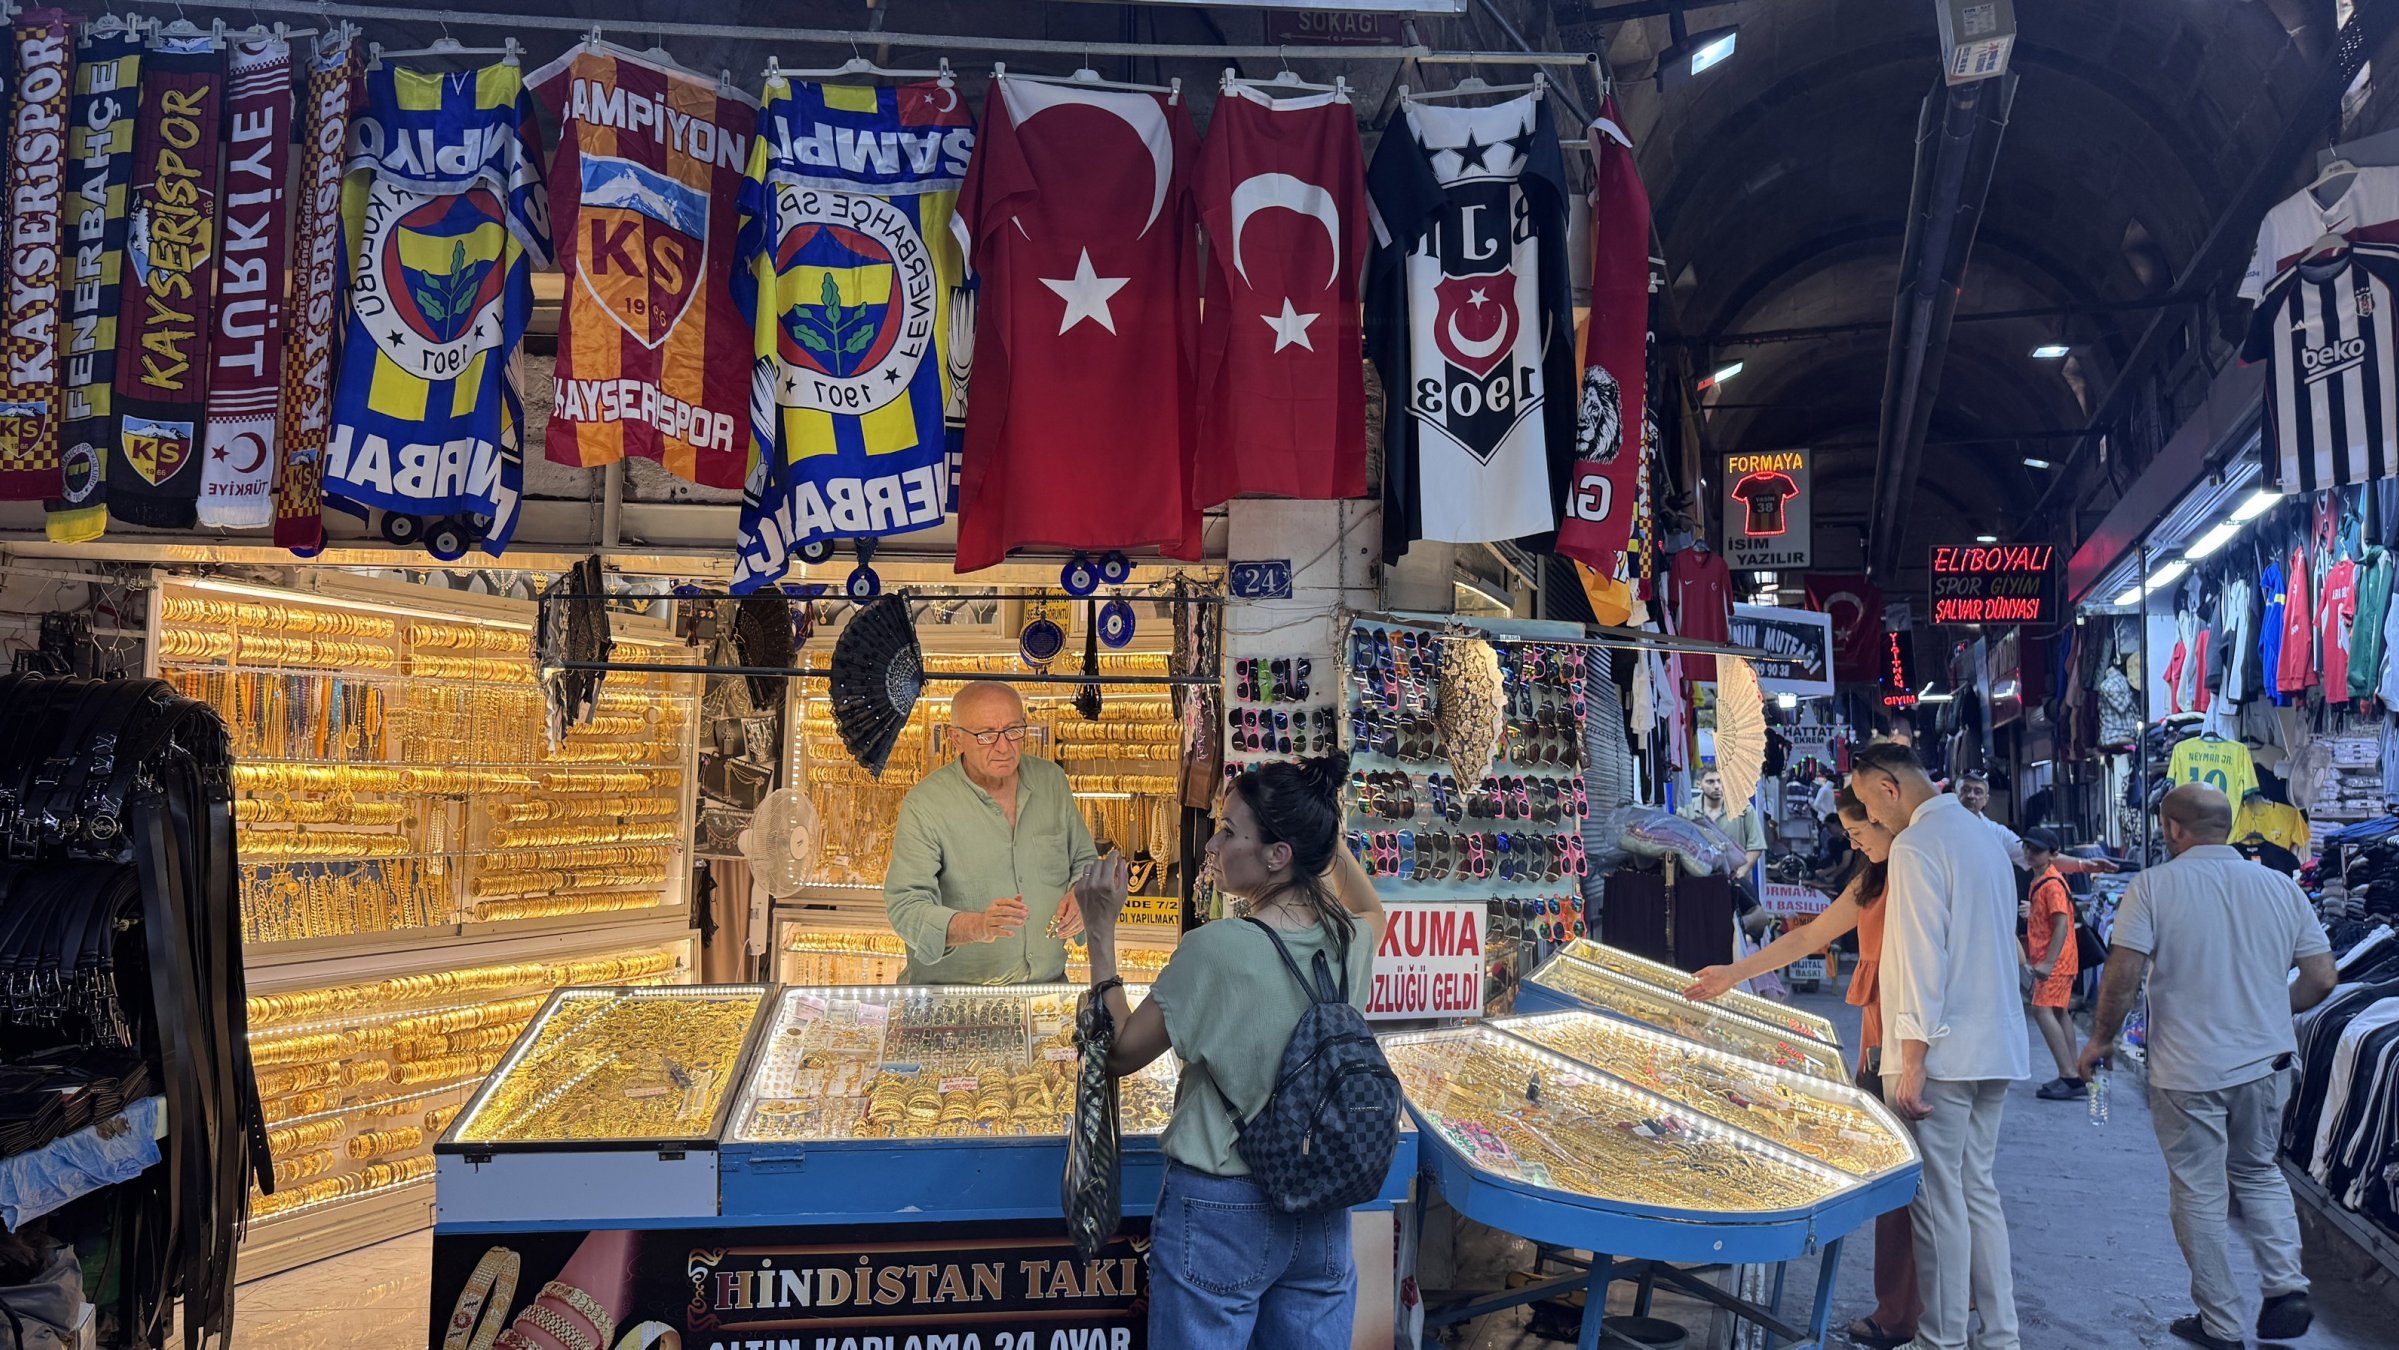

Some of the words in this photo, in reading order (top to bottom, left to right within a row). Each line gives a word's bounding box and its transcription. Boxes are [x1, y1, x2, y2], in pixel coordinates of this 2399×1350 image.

[559, 78, 745, 174] AMPİYON
[66, 60, 121, 420] FENERBAHÇE
[141, 84, 210, 391] KAYSERİSPOR
[300, 80, 348, 432] KAYSERİSPOR
[591, 218, 684, 295] KS
[2302, 337, 2365, 370] beko
[131, 439, 181, 463] KS
[1728, 453, 1803, 474] FORMAYA
[1757, 502, 1774, 513] 38
[1736, 552, 1805, 566] YAZILIR
[1243, 568, 1278, 594] 24
[1935, 576, 1983, 595] SPOR
[1990, 574, 2040, 595] GİYİM
[1935, 599, 1984, 624] ŞALVAR
[1985, 596, 2040, 620] DÜNYASI
[1783, 726, 1834, 737] HATTAT
[1794, 736, 1824, 744] EKREM
[2188, 752, 2220, 763] NEYMAR
[1432, 964, 1478, 1011] GELDİ
[714, 1255, 1005, 1310] HİNDİSTAN
[1020, 1259, 1137, 1299] TAKI
